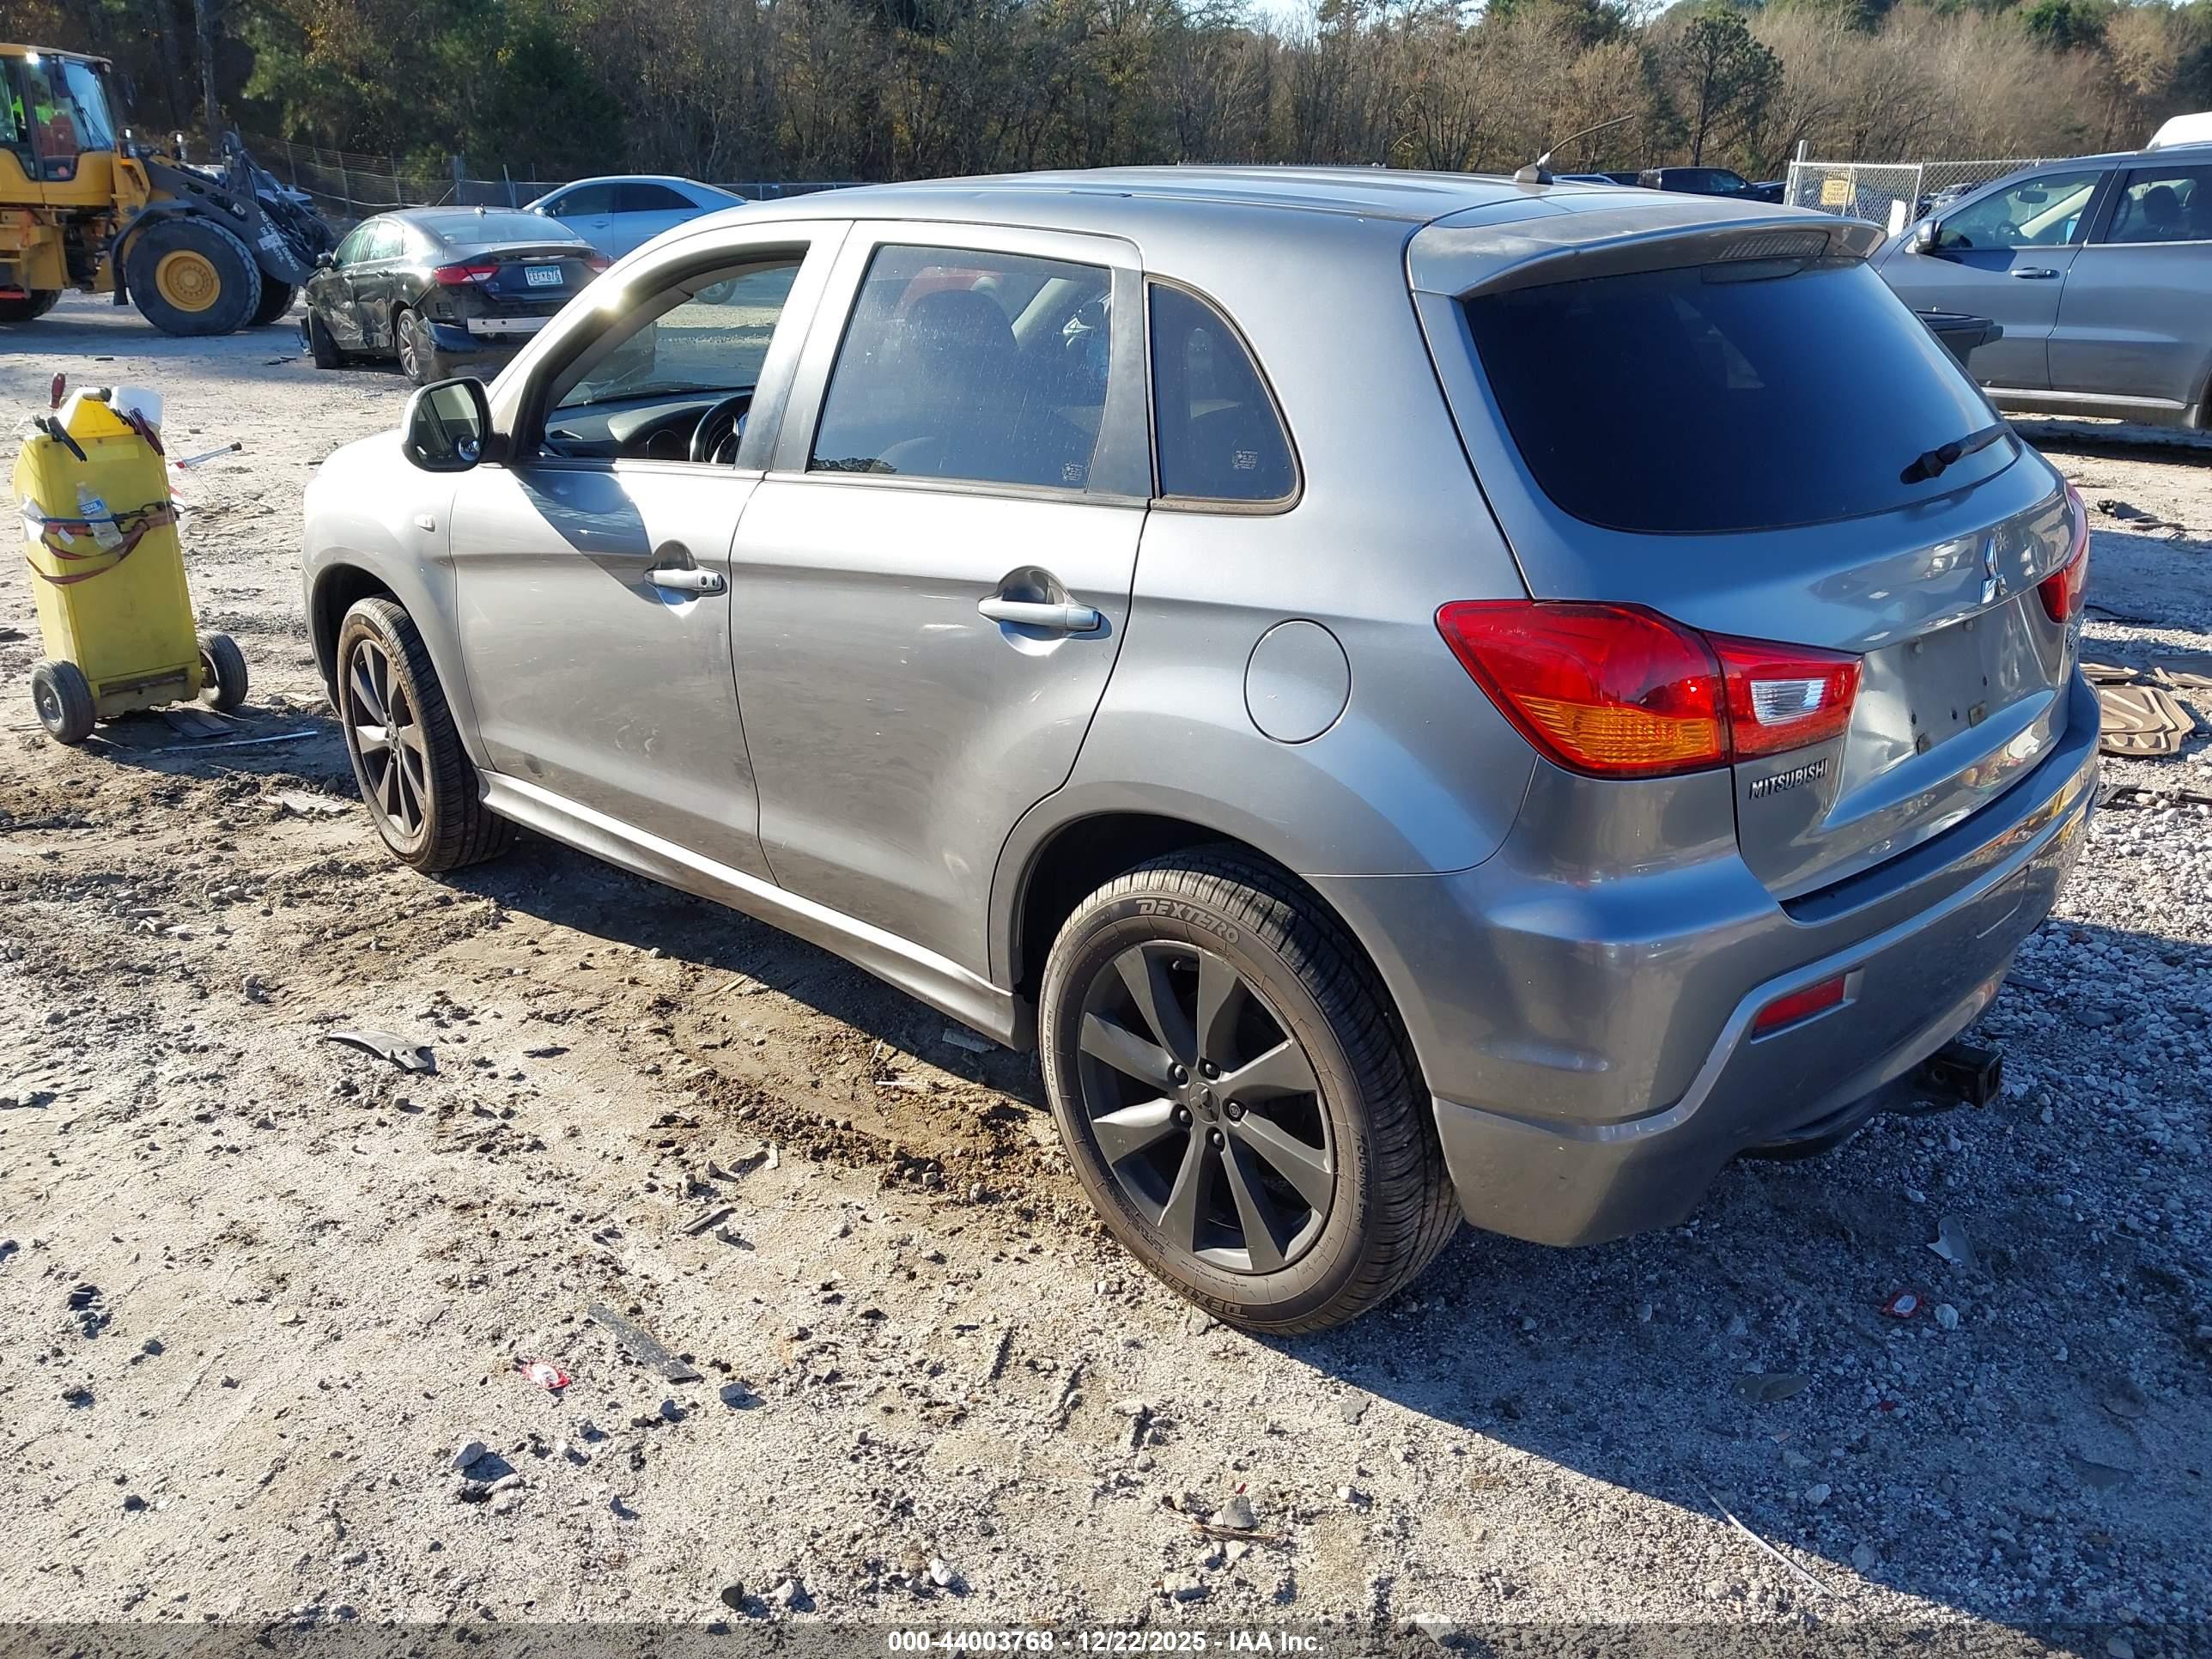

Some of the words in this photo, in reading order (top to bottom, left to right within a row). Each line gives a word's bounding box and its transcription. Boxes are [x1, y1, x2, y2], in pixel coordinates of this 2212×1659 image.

[1749, 757, 1827, 799] MITSUBISHI
[1136, 899, 1239, 944] DEXTERO
[1044, 1034, 1055, 1089] TOURING
